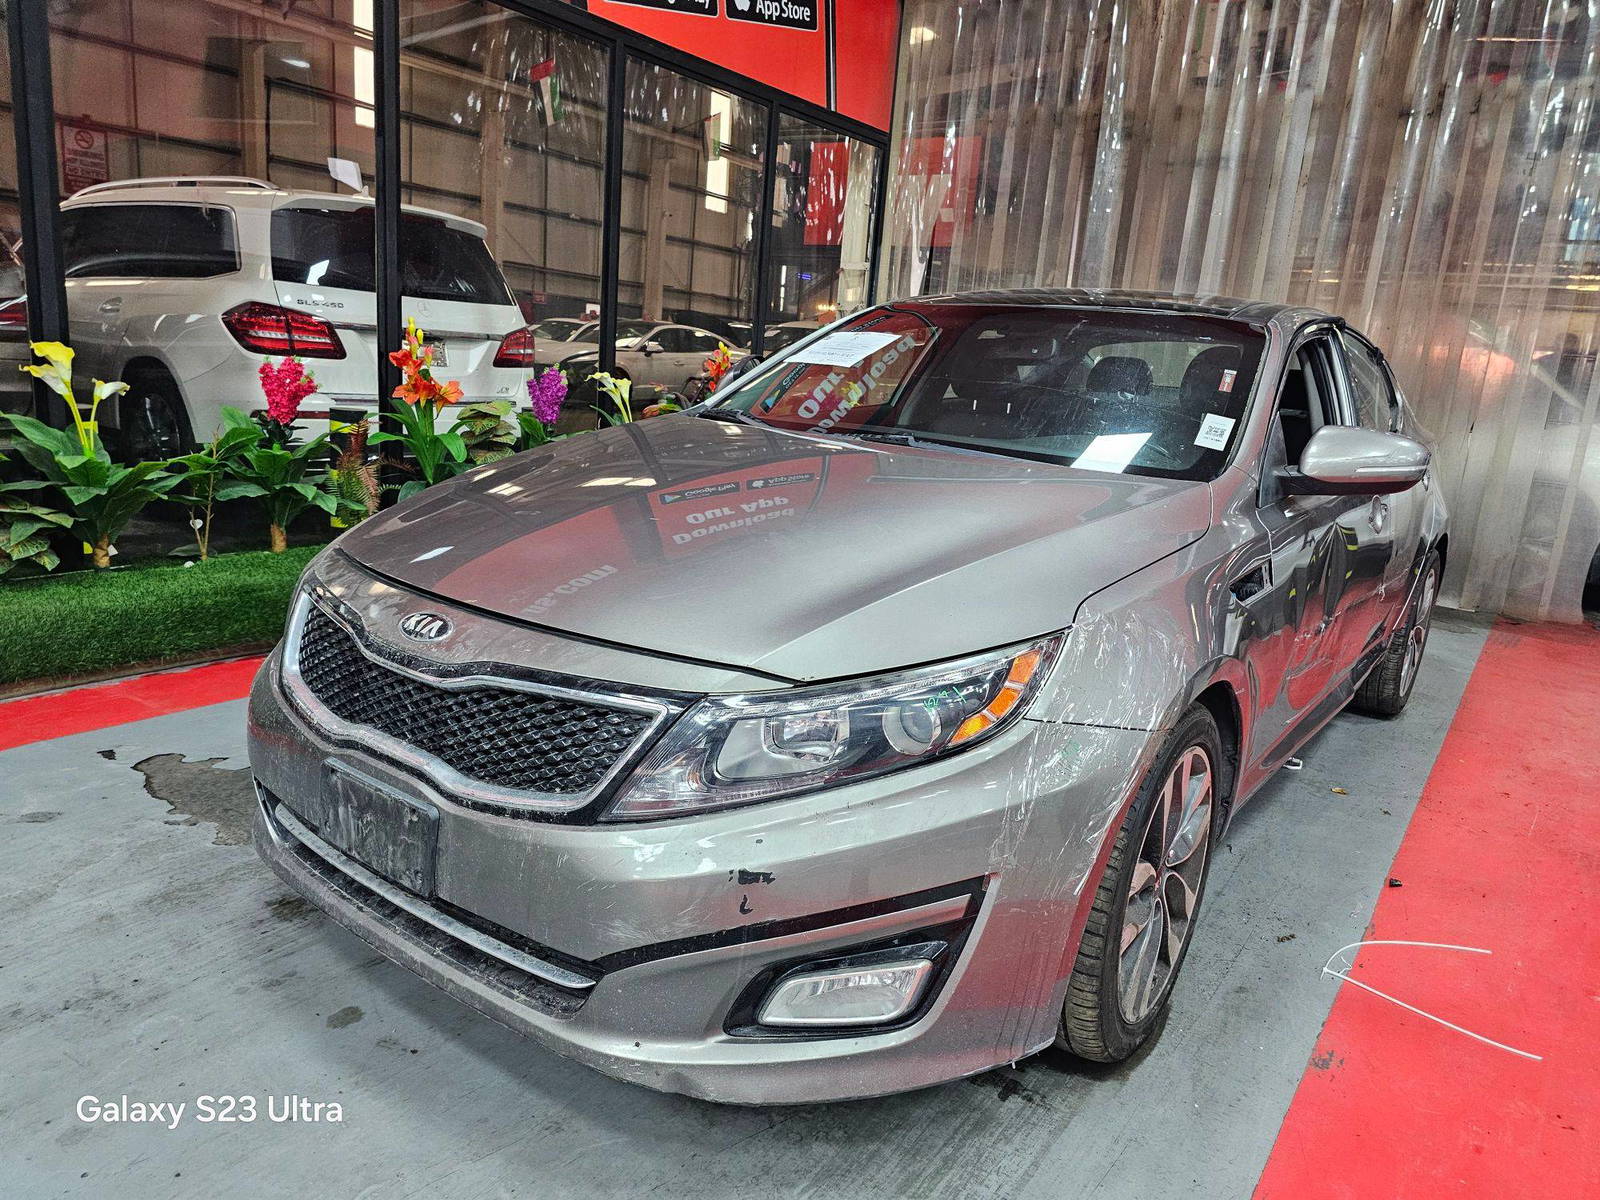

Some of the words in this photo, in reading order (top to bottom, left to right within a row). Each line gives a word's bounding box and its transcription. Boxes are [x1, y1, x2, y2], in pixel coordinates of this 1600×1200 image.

[756, 0, 780, 20] App
[782, 1, 810, 21] Store
[296, 298, 320, 307] GLS
[320, 301, 345, 310] 450
[403, 614, 444, 638] KIA
